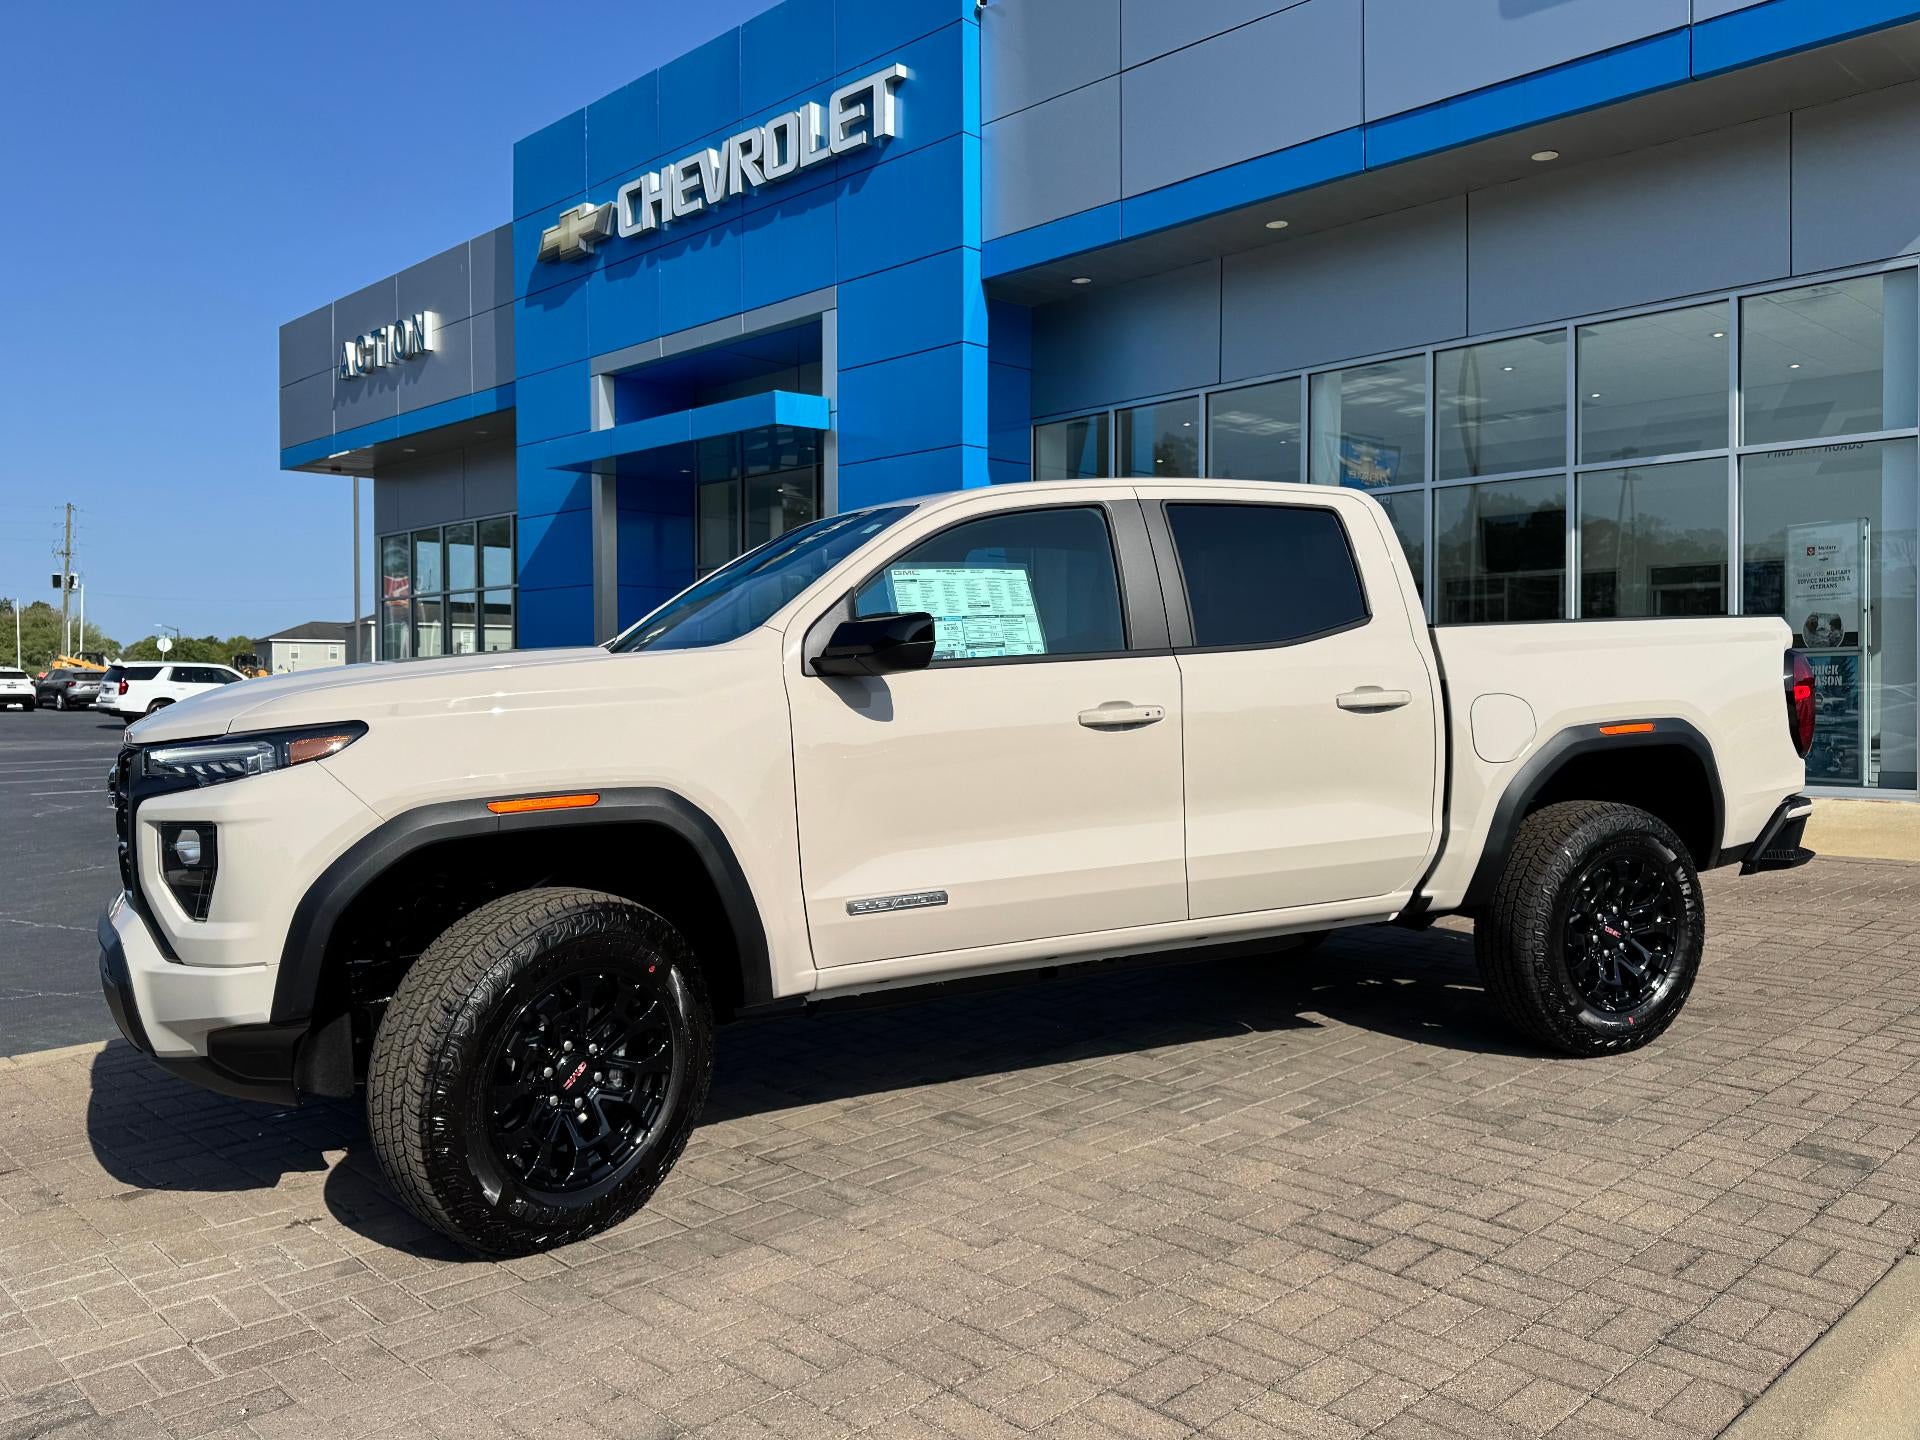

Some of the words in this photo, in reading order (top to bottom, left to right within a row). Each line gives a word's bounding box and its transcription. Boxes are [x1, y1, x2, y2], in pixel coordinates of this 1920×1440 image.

[617, 63, 907, 238] CHEVROLET
[338, 310, 434, 380] ACTION
[1811, 664, 1839, 675] RUCK
[1604, 926, 1621, 939] GMC
